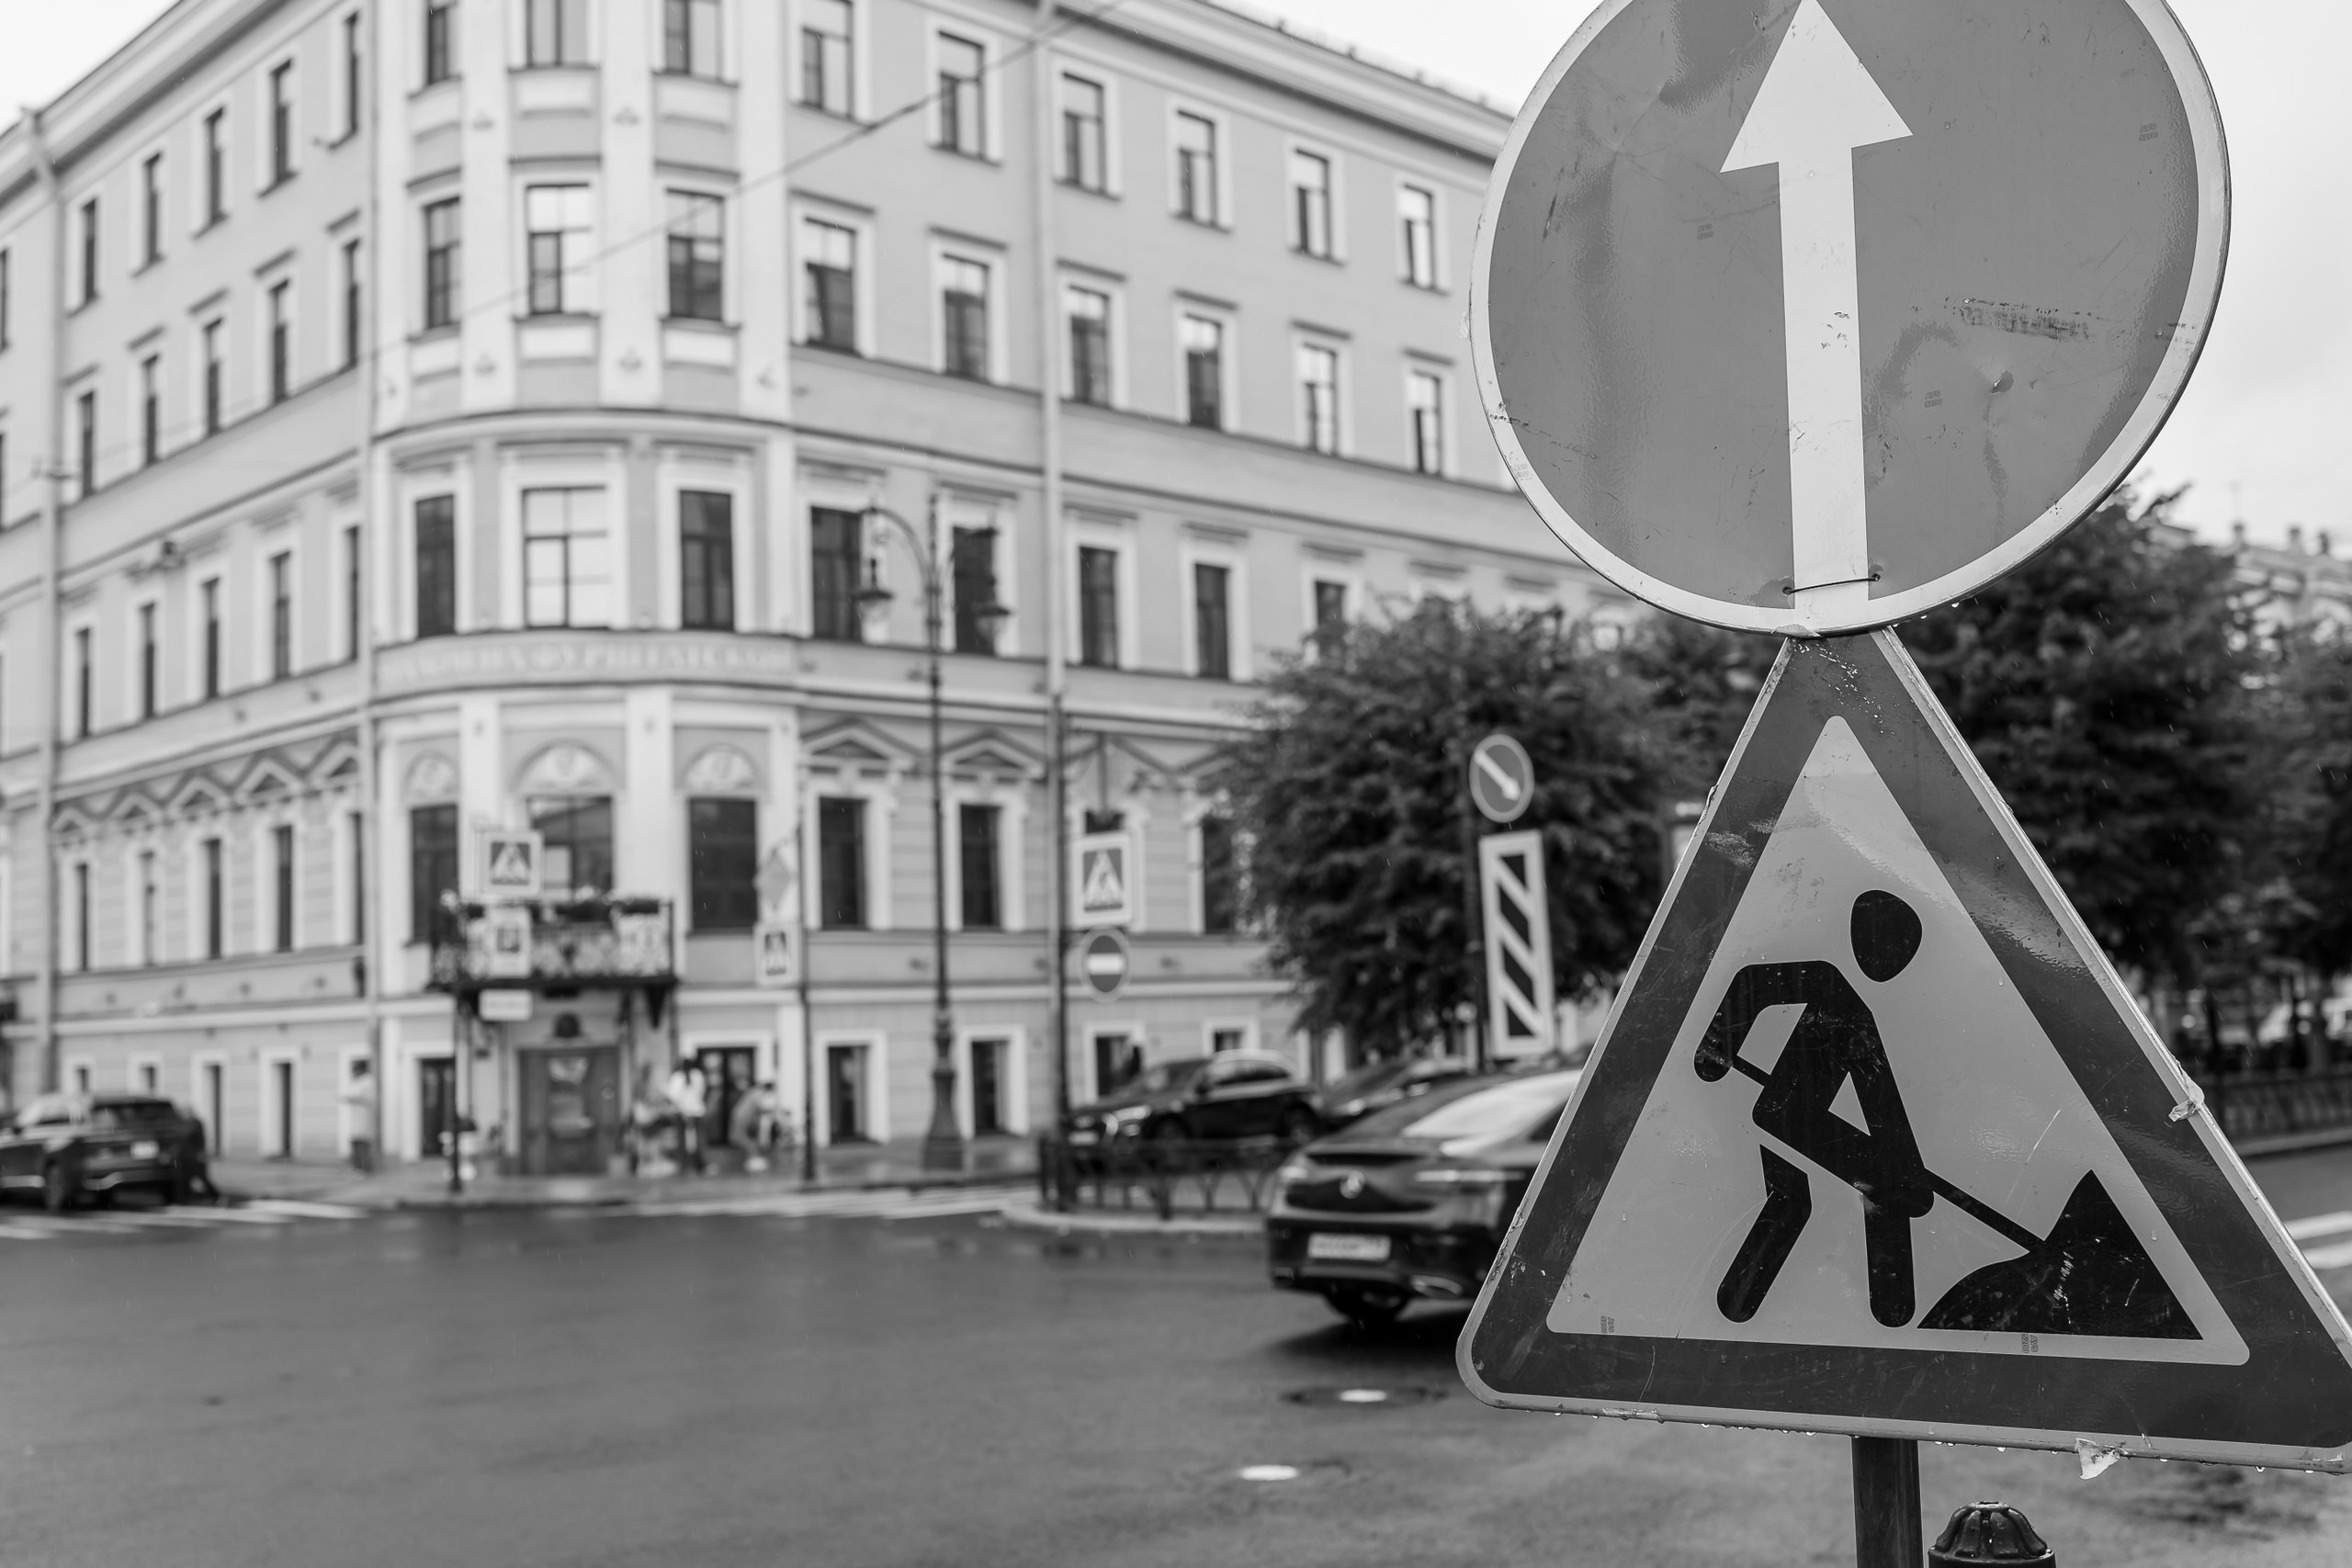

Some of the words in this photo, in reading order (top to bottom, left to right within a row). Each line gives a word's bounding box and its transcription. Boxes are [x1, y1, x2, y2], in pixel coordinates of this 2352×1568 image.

[2139, 123, 2157, 133] AVS
[1925, 390, 1941, 400] AVS
[2021, 1334, 2030, 1354] 5200
[2030, 1335, 2039, 1352] AVS
